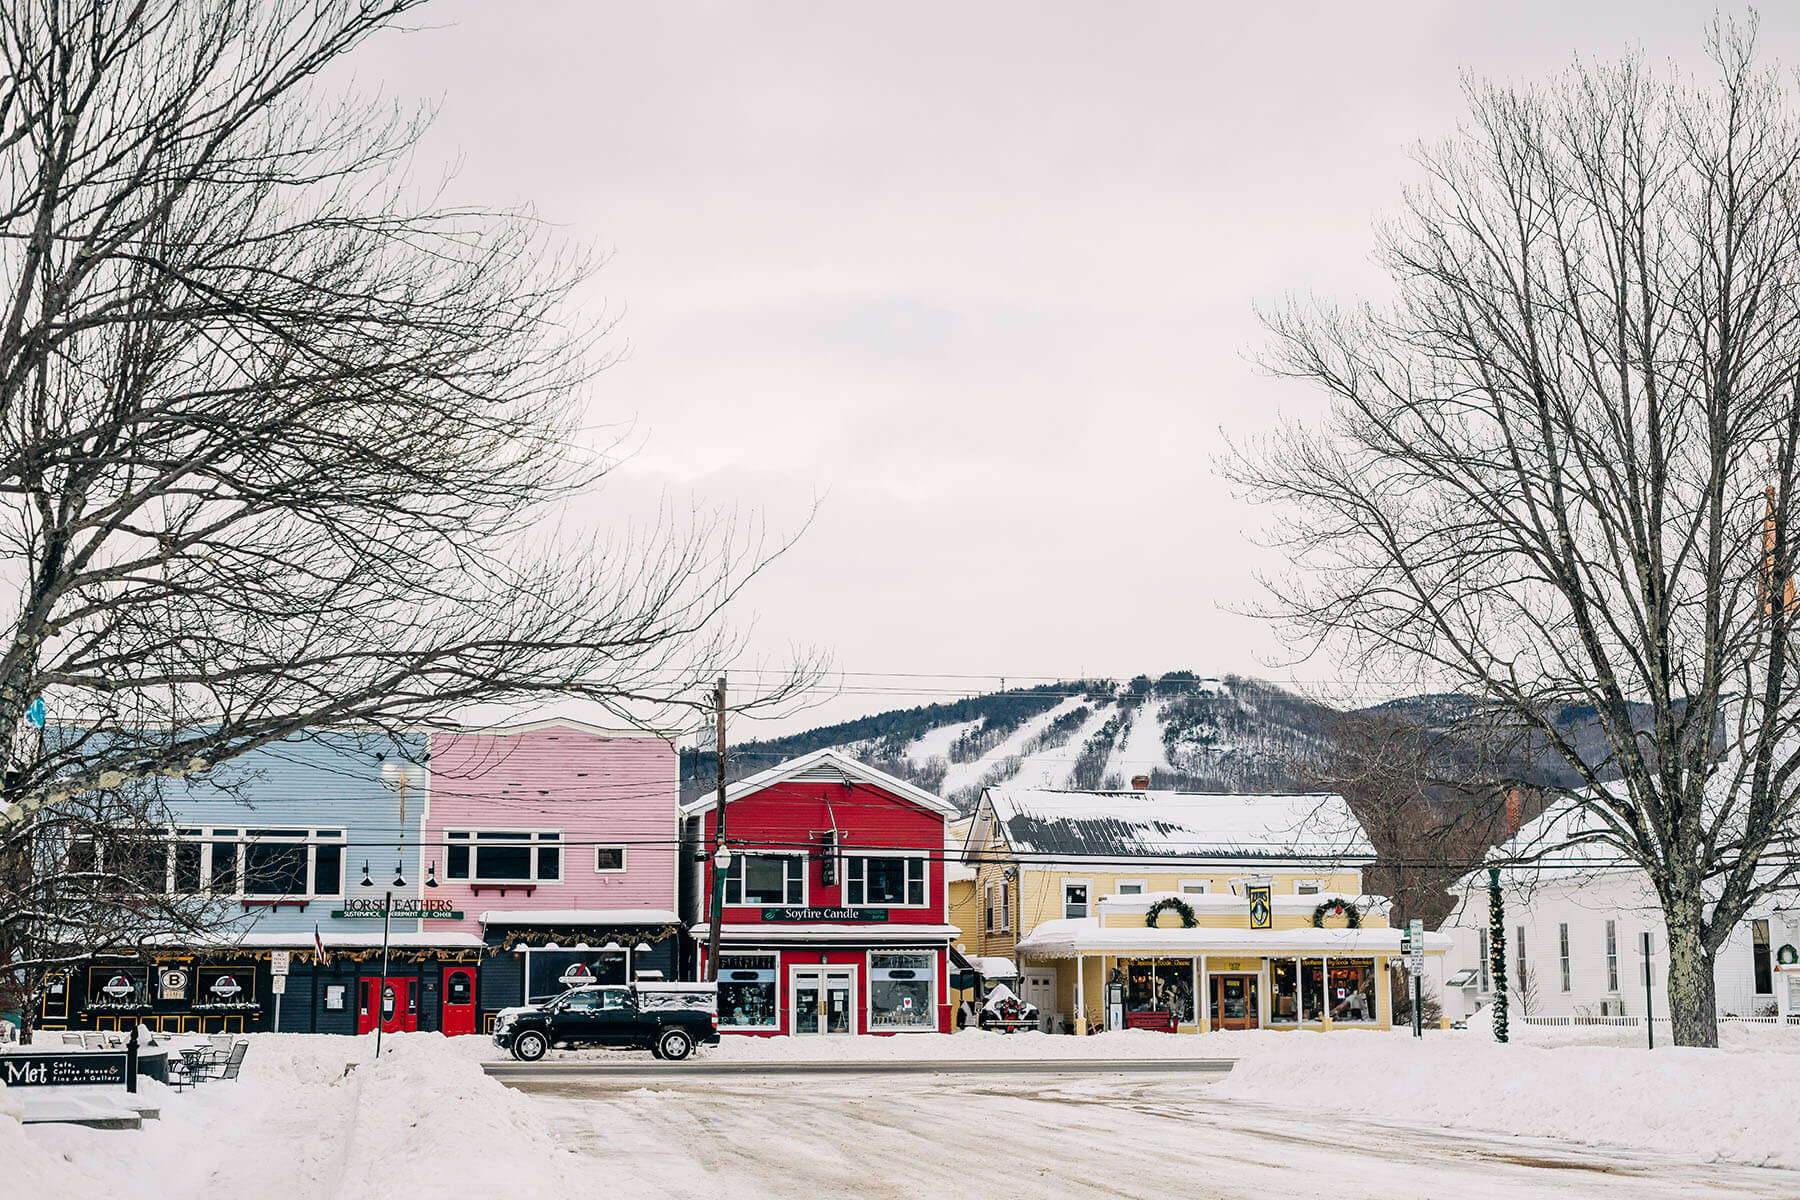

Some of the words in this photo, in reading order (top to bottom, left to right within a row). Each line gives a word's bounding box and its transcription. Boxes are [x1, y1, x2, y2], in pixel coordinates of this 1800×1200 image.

[344, 899, 453, 911] HORSEEATHERS
[785, 908, 821, 920] Soyfire
[823, 908, 859, 918] Candle
[169, 974, 180, 986] B
[5, 1061, 47, 1083] Met
